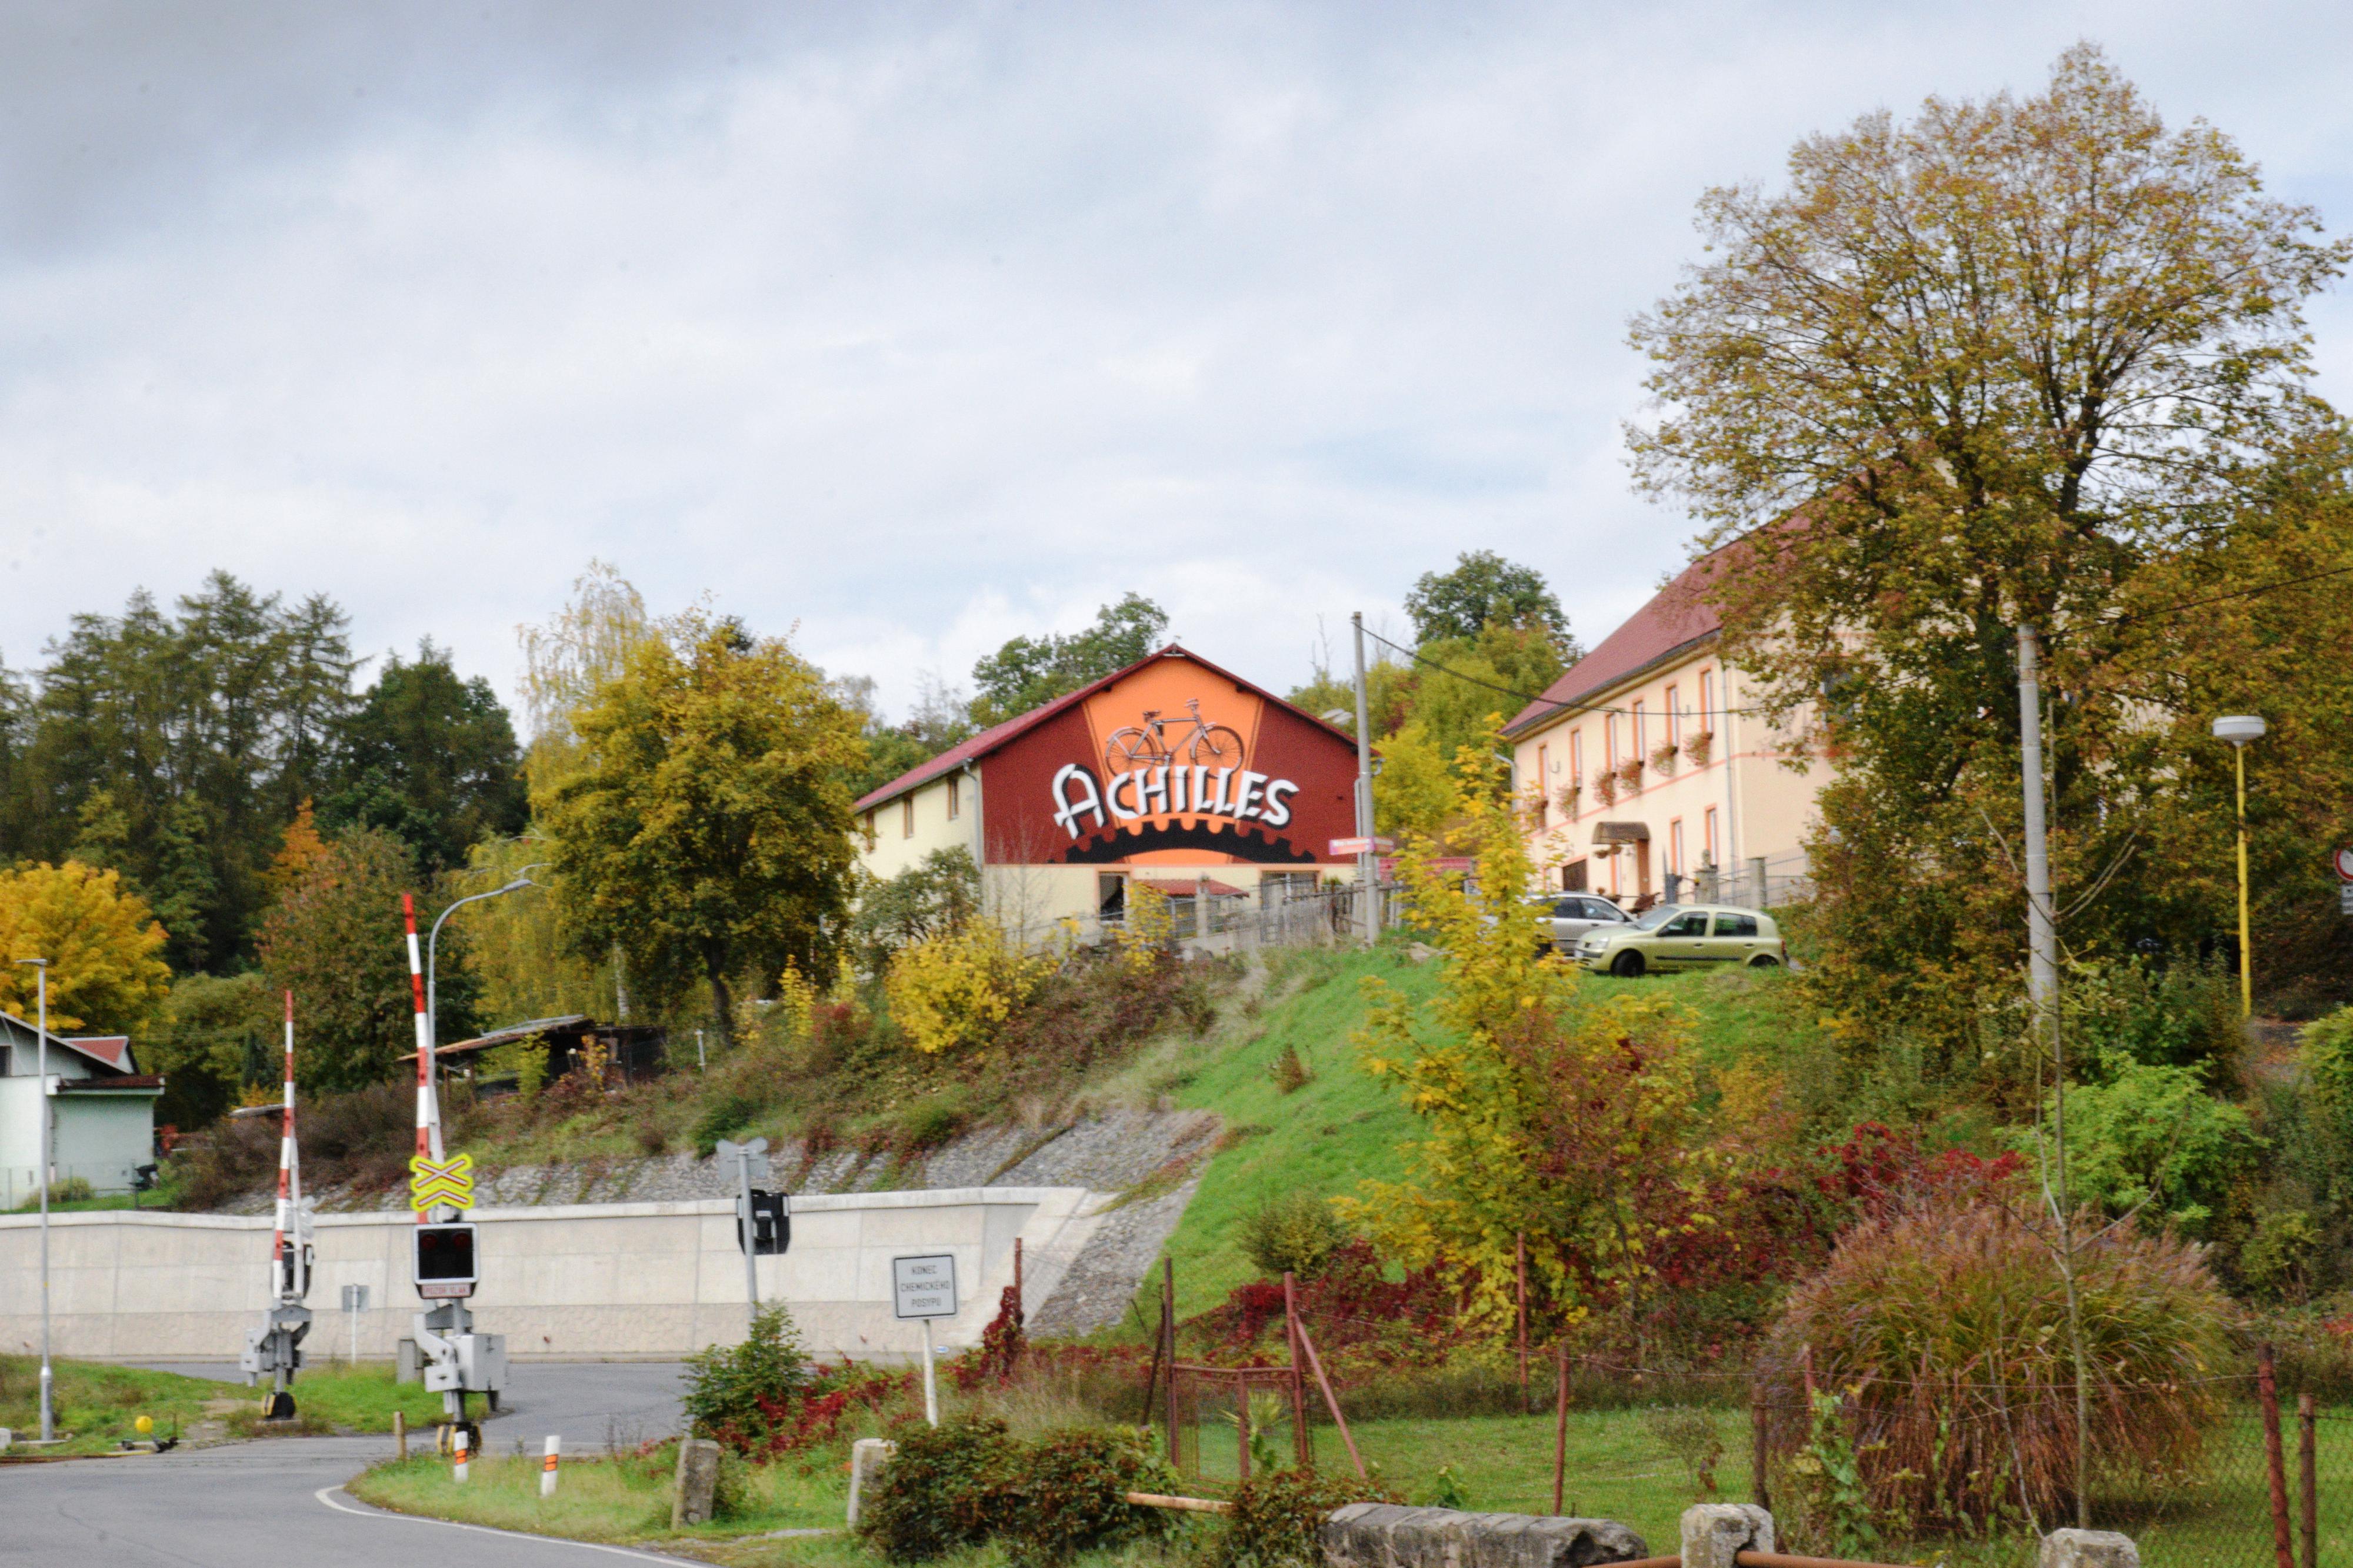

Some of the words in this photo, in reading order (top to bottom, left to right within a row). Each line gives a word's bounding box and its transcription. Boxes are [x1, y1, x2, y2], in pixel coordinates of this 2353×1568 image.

[1052, 763, 1299, 840] ACHILLES
[912, 1265, 938, 1275] KONEC
[912, 1297, 942, 1307] POSYPU
